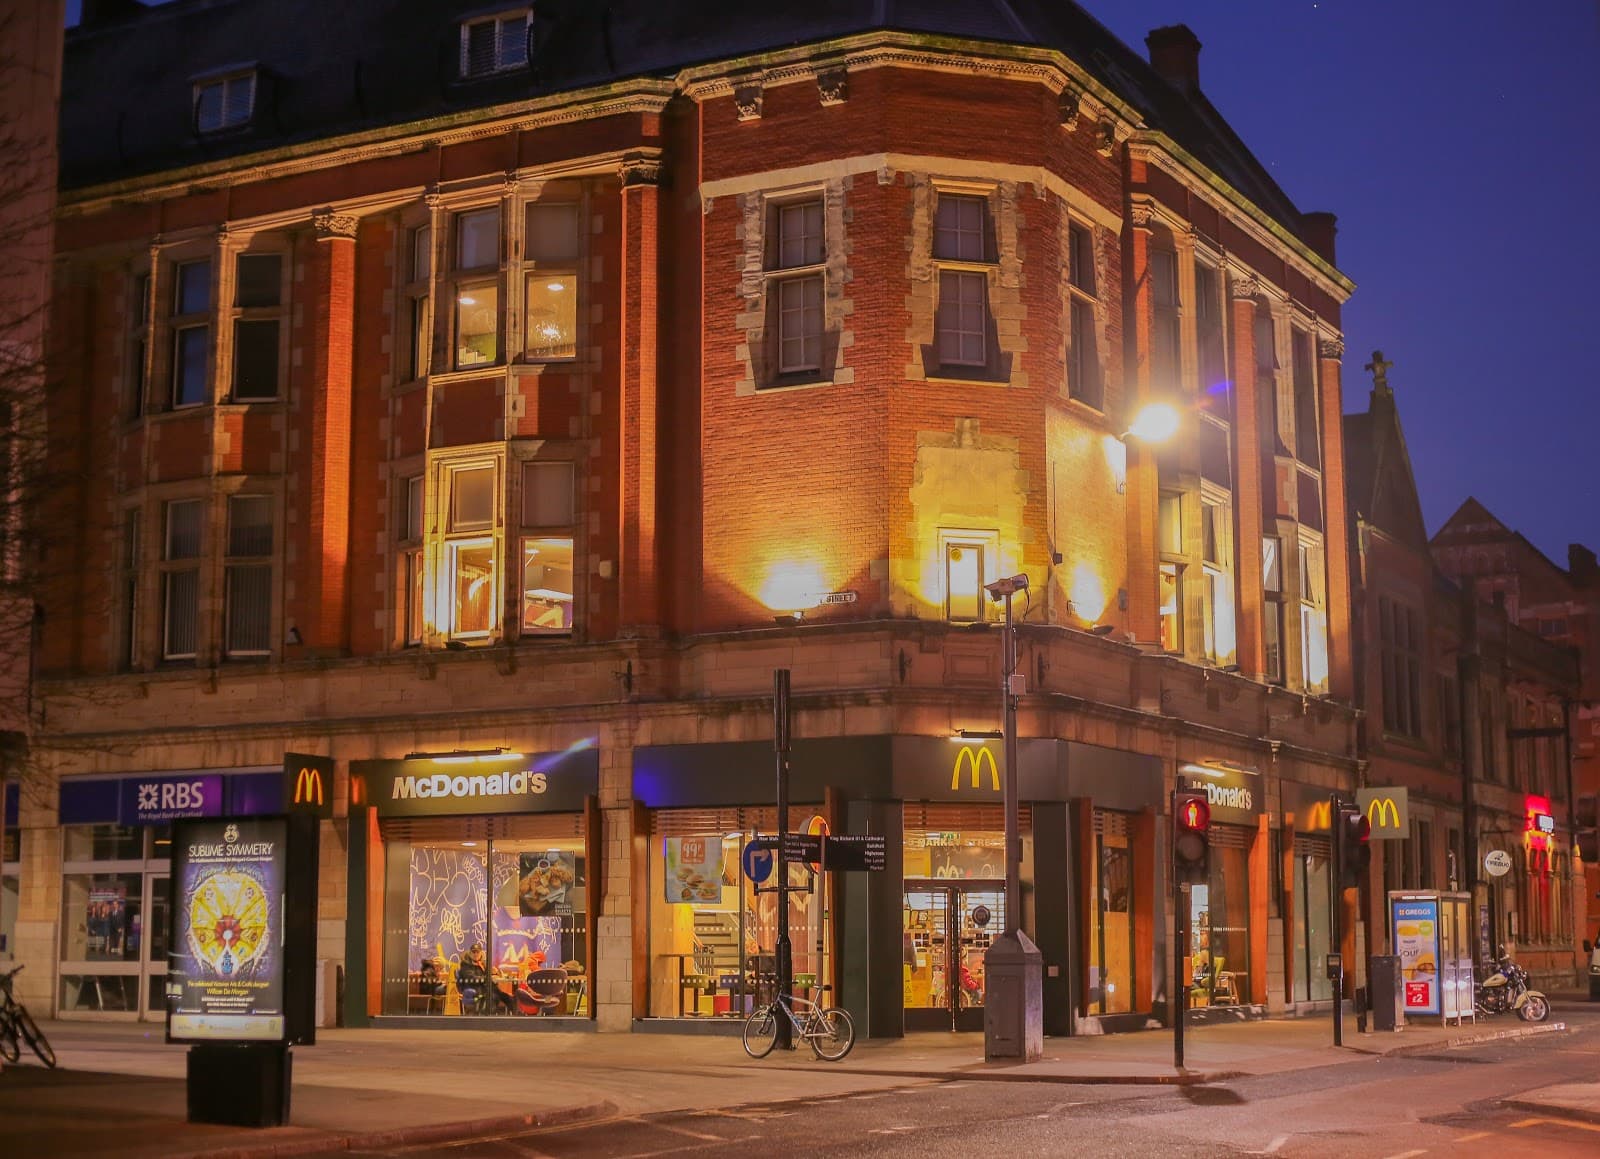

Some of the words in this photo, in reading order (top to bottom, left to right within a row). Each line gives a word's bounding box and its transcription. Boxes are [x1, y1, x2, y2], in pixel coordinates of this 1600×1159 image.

[161, 781, 204, 810] RBS
[391, 770, 548, 800] McDonald's
[1192, 780, 1252, 810] Donald's
[188, 844, 224, 858] SUBLIME
[225, 842, 274, 857] SYMMETRY
[1405, 908, 1431, 916] GREGGS
[1412, 993, 1423, 1003] £2
